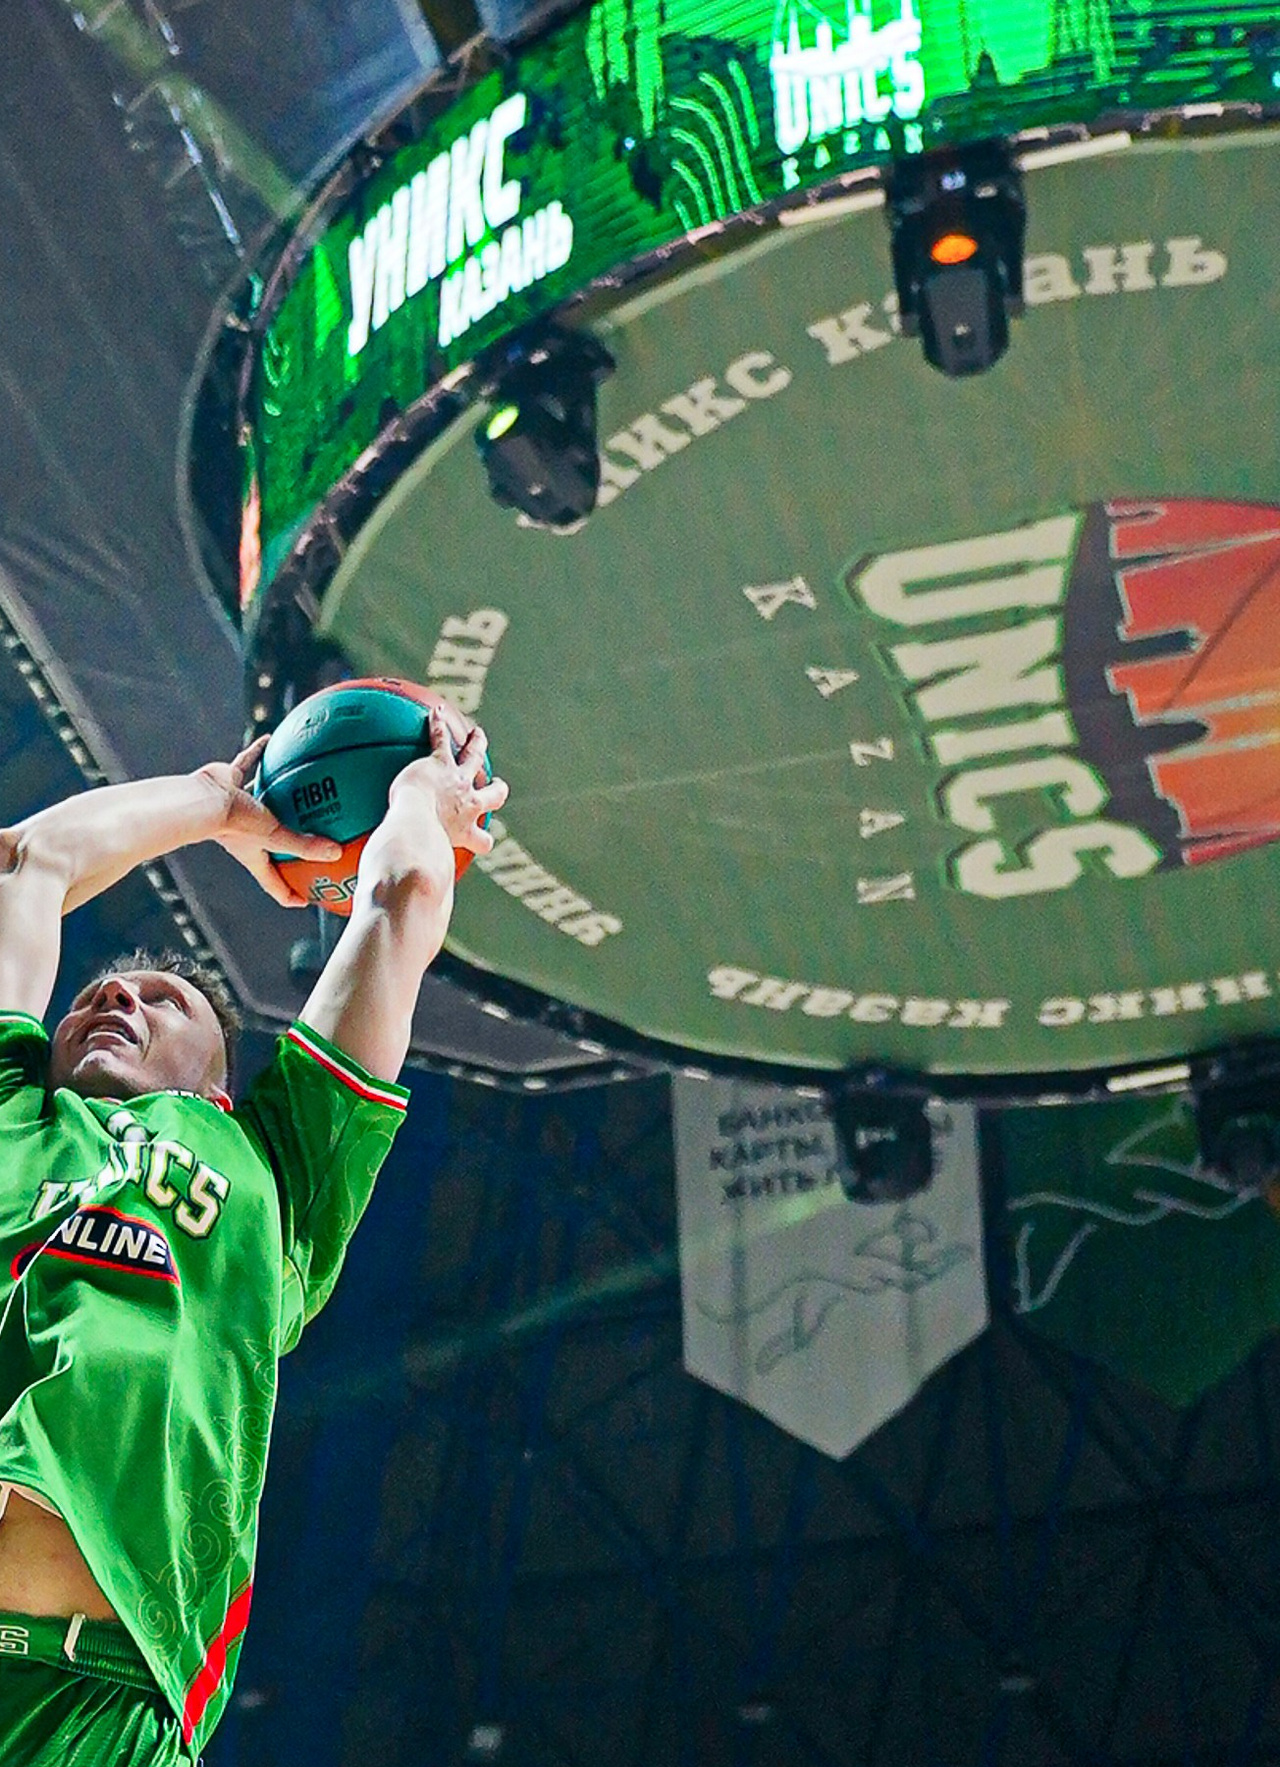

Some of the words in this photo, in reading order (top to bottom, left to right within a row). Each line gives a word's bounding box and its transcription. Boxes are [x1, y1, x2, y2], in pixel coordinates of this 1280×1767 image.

[772, 36, 926, 155] UNICS
[852, 510, 1165, 901] UNICS
[291, 775, 339, 814] FIBA
[58, 1215, 168, 1266] NLINE
